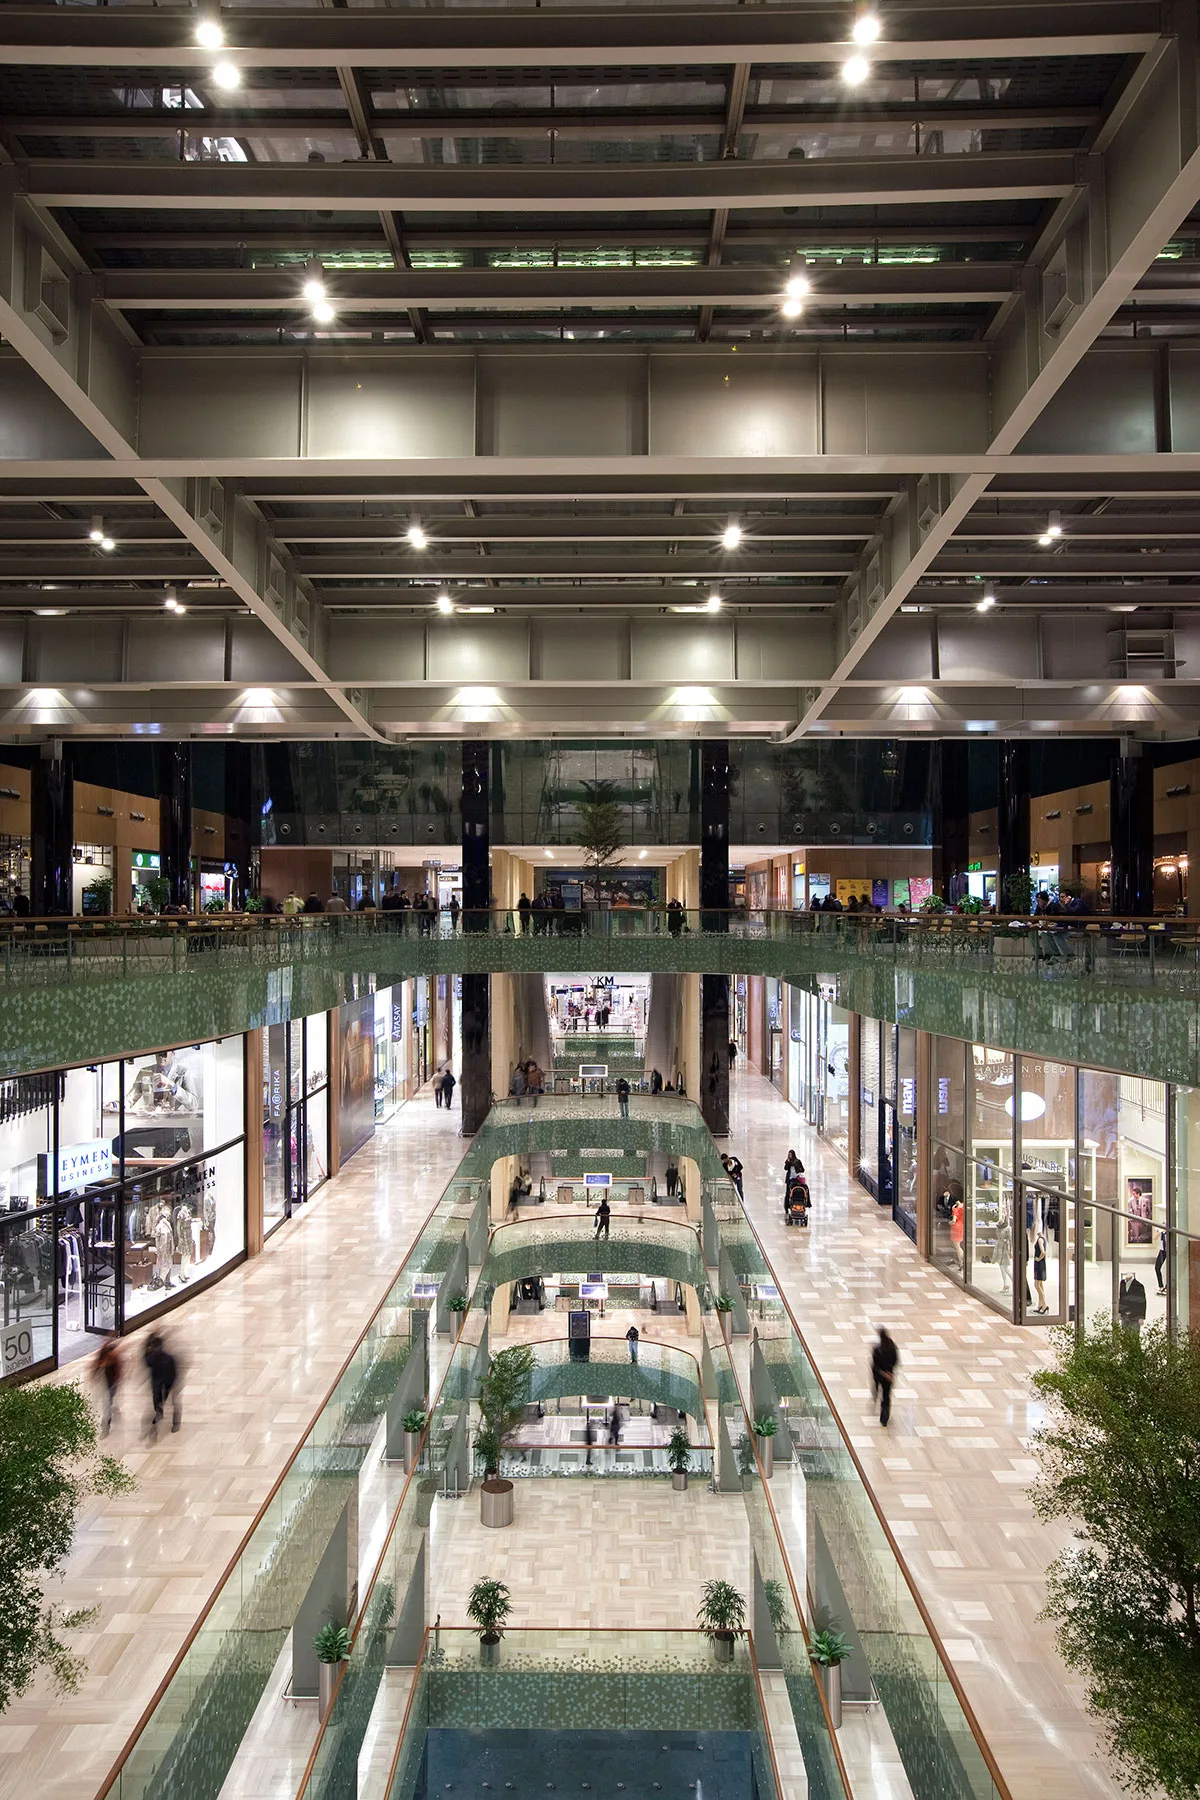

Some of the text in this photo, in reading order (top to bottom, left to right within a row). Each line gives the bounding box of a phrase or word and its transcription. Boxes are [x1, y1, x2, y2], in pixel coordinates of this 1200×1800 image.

[588, 975, 614, 986] YKM
[391, 1004, 401, 1039] ATASAY
[984, 1065, 1067, 1075] AUSN REED
[900, 1077, 914, 1114] mavi
[62, 1148, 109, 1171] EYMEN
[1020, 1153, 1048, 1169] USTIN
[61, 1163, 109, 1183] USINESS
[5, 1331, 31, 1361] 50
